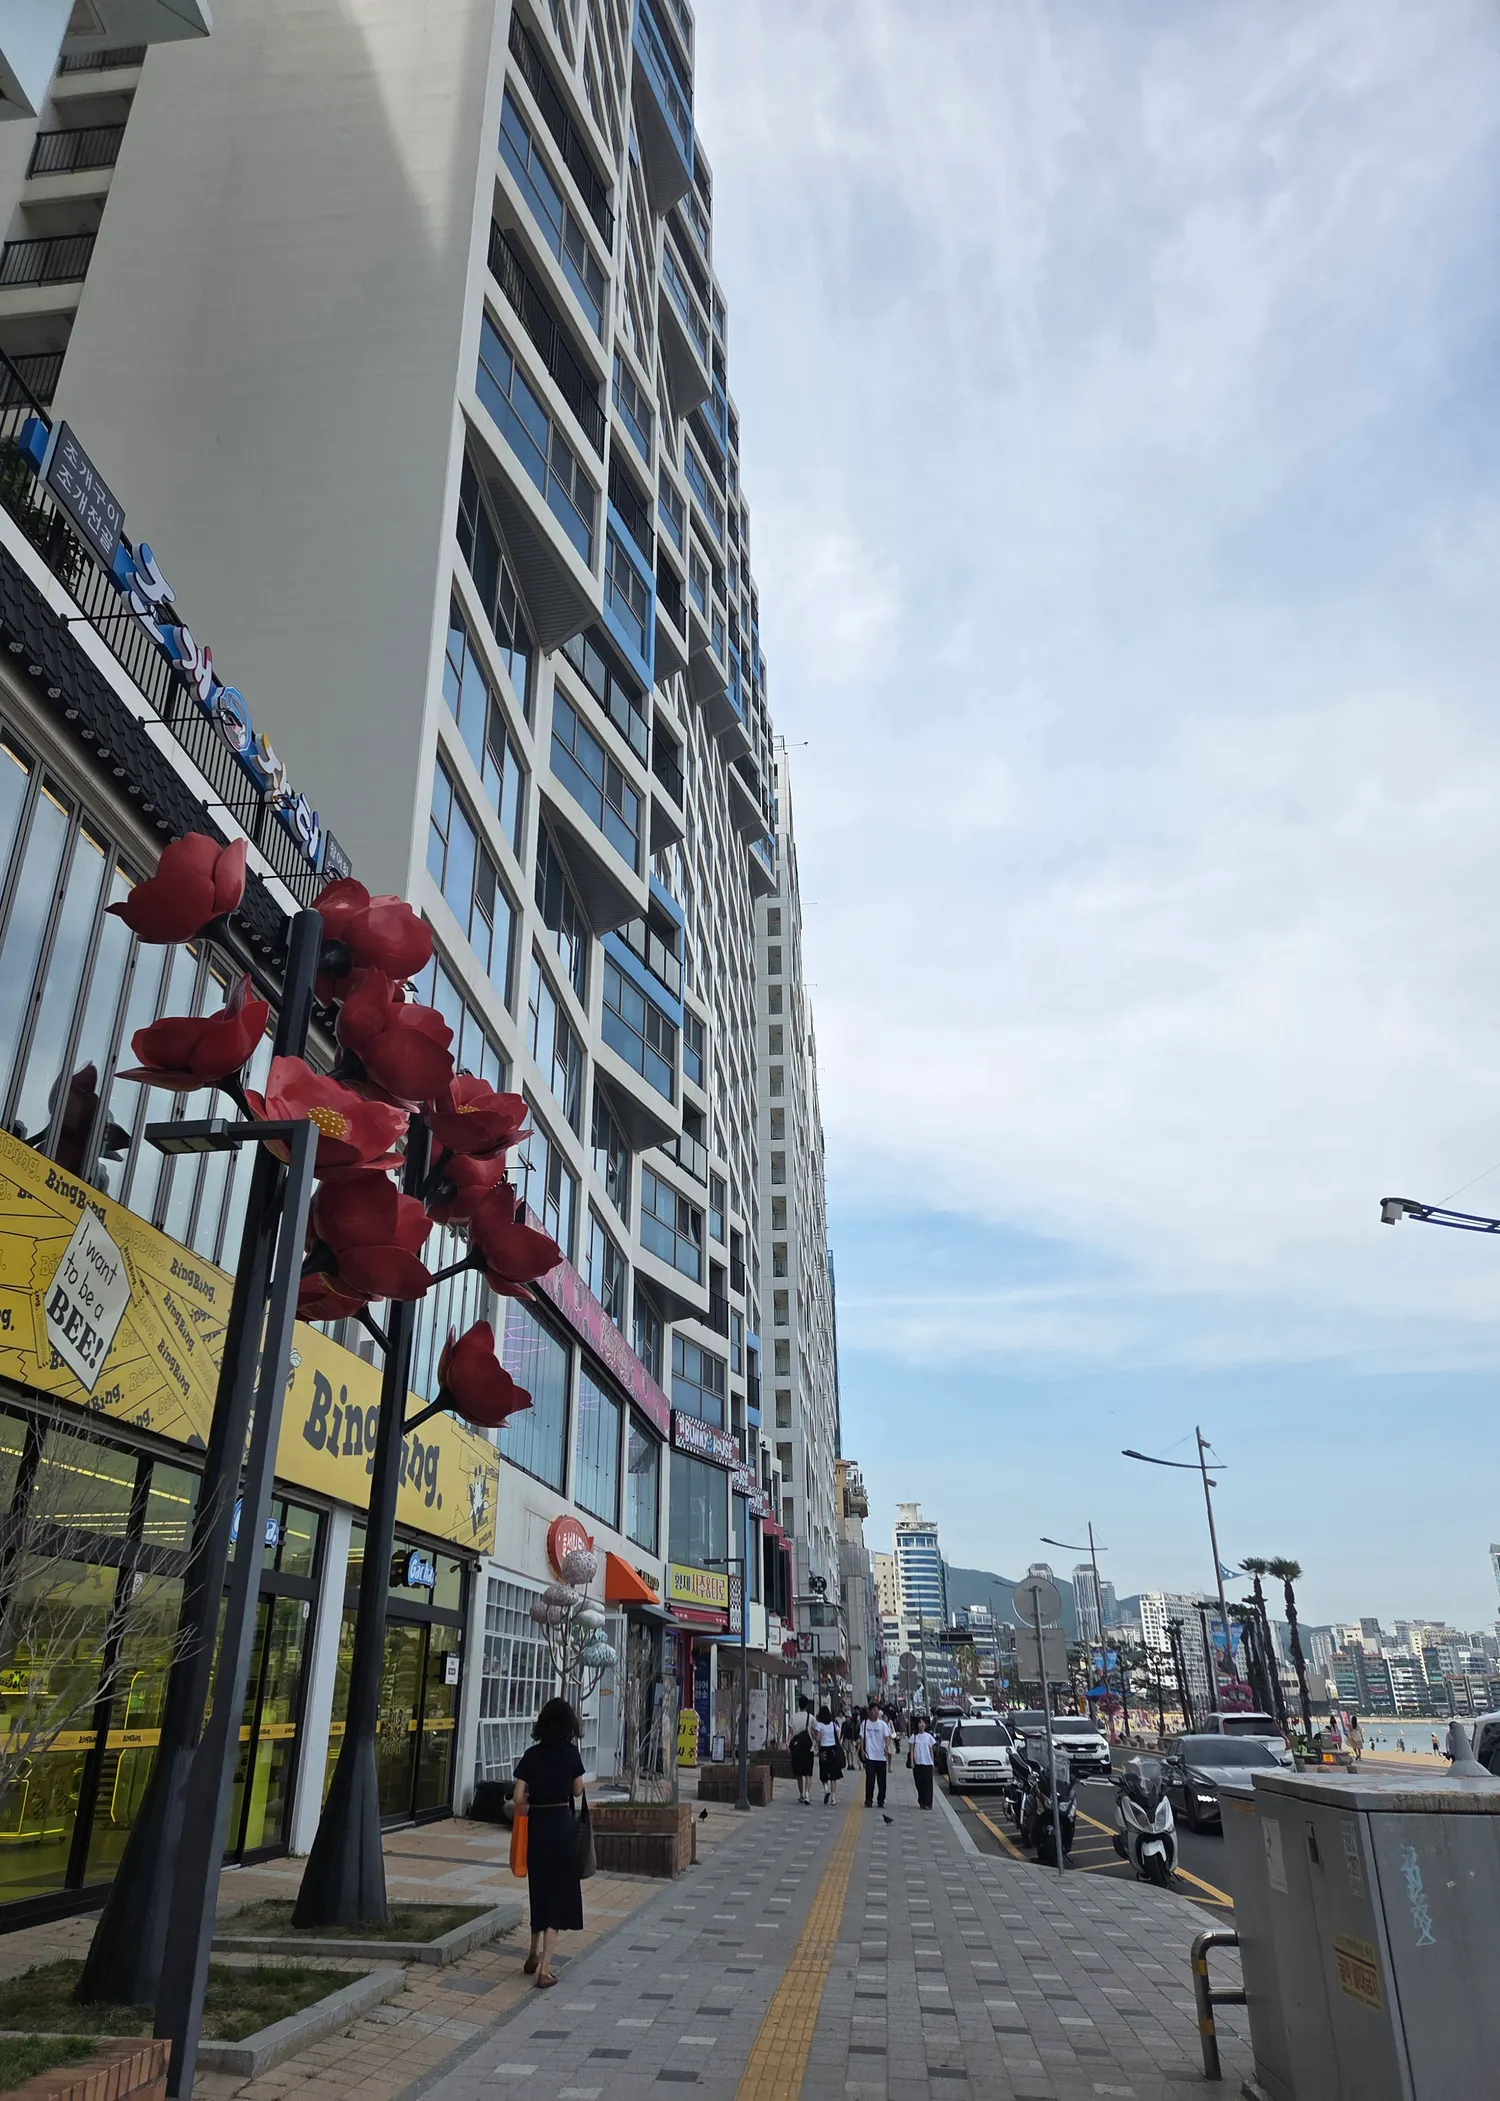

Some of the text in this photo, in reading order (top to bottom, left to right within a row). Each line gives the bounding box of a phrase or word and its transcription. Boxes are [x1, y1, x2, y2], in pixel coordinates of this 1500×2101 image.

[56, 463, 113, 554] 조개전골
[63, 440, 119, 531] 조개구이
[63, 1251, 105, 1322] to be a
[78, 1222, 119, 1287] I want
[169, 1256, 216, 1305] BingBing.
[46, 1284, 104, 1370] BEE!
[163, 1291, 195, 1357] BingBing.
[157, 1337, 191, 1401] BingBing.
